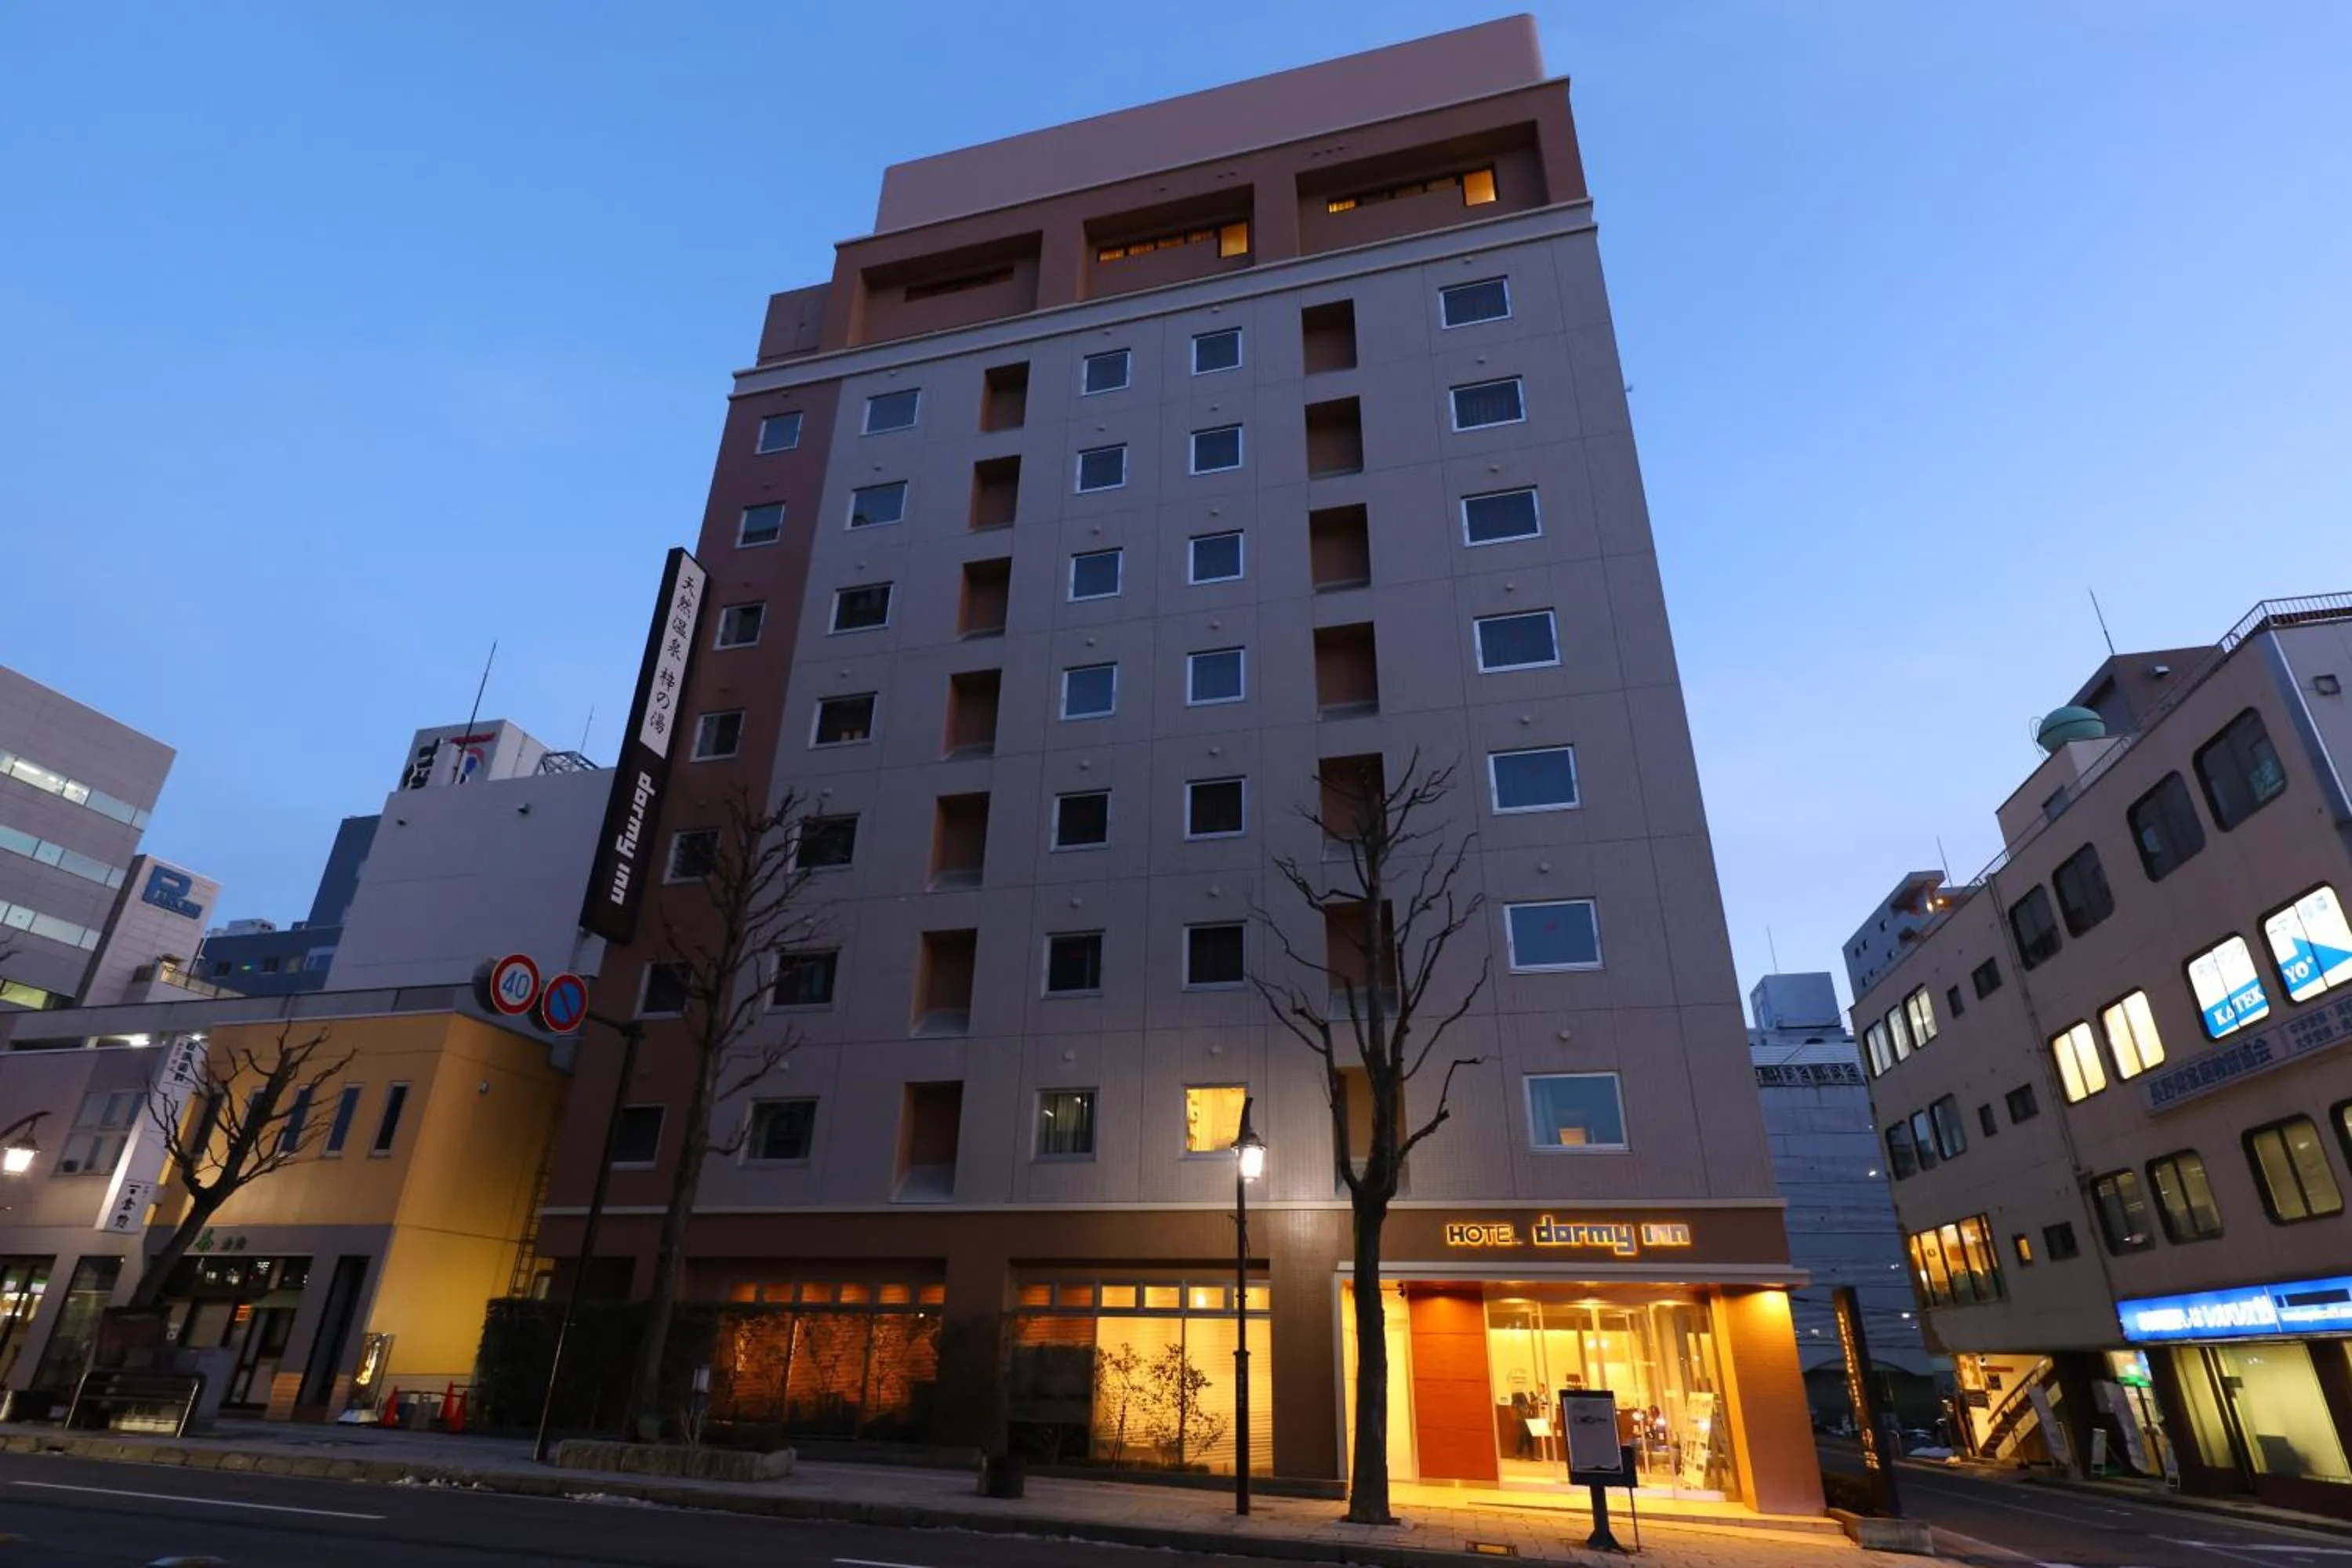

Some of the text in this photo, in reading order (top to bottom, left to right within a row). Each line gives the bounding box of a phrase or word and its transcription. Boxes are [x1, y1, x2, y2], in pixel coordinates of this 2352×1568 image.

[668, 576, 695, 662] 天然温泉
[615, 771, 655, 859] dormy
[503, 971, 530, 999] 40
[1447, 1225, 1525, 1245] HOTEL
[1534, 1215, 1636, 1255] dormy
